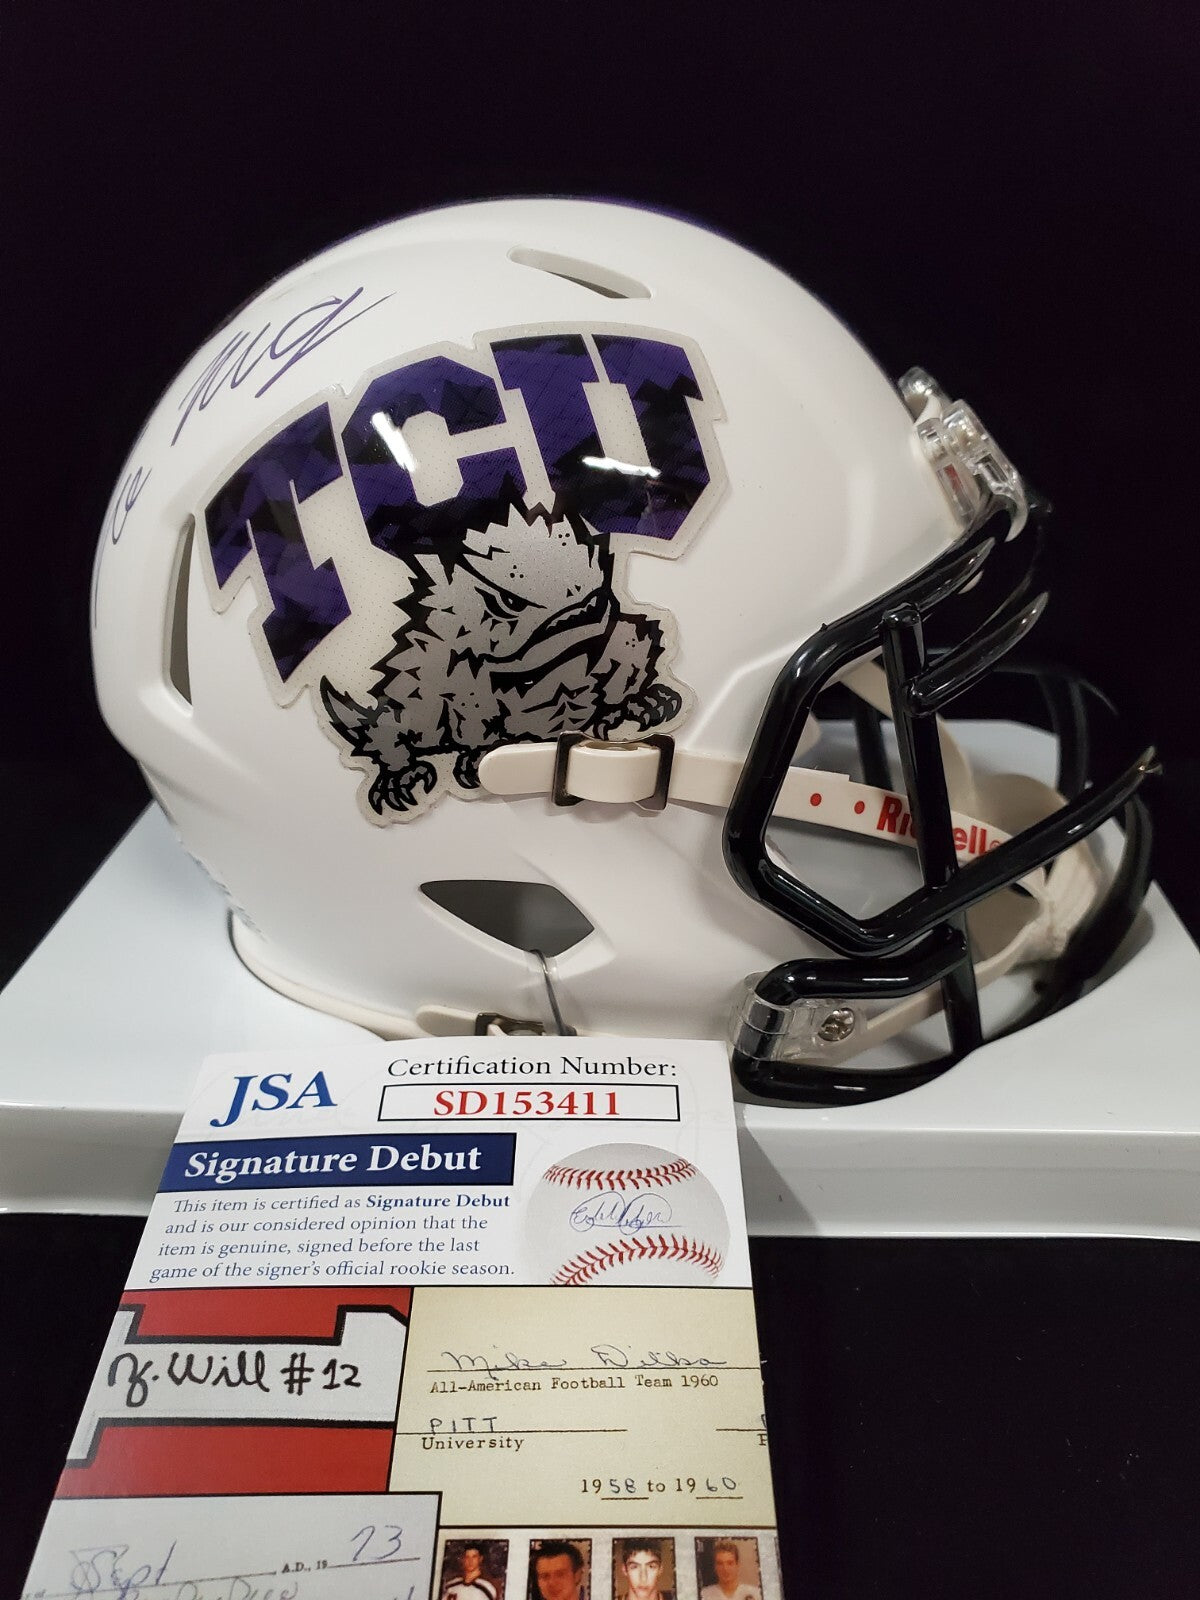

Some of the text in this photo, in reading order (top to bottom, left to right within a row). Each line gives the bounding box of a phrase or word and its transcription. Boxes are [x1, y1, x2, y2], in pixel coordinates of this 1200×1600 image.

[204, 333, 711, 683] TCU
[876, 795, 987, 855] Riell
[388, 1056, 676, 1076] Certification Number:
[210, 1071, 337, 1127] JSA
[434, 1091, 619, 1115] SD153411
[184, 1144, 482, 1184] Signature Debut
[174, 1194, 509, 1213] This item is certified as Signature Debut
[165, 1217, 488, 1234] and is our considered opinion that the
[158, 1238, 479, 1258] item is genuine, signed before the last
[150, 1266, 197, 1282] game
[202, 1263, 224, 1277] of
[224, 1263, 251, 1277] the
[326, 1261, 384, 1275] official
[390, 1261, 447, 1275] rookie
[452, 1264, 514, 1275] season.
[281, 1352, 361, 1395] #12
[430, 1375, 719, 1393] All-American Football Team 1960
[430, 1417, 498, 1434] PITT
[421, 1436, 525, 1452] University
[648, 1479, 666, 1492] to
